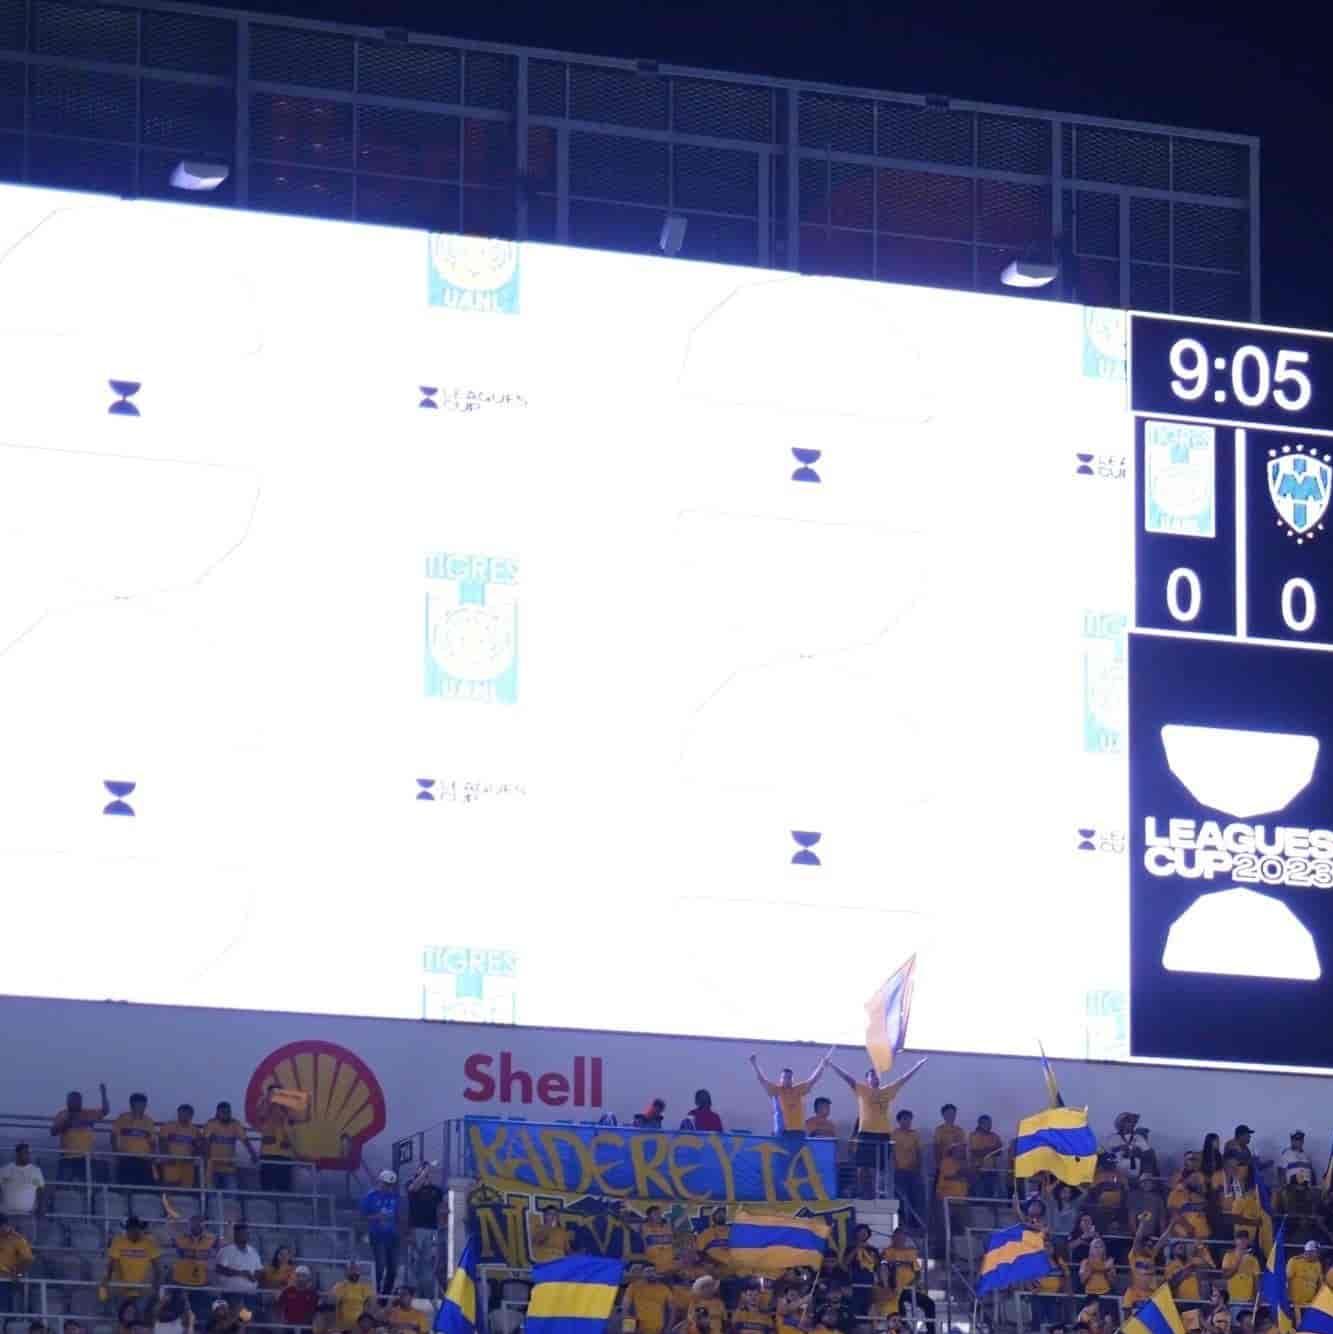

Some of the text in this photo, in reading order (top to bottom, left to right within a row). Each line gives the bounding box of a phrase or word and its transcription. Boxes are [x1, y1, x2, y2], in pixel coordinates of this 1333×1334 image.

[1168, 338, 1312, 411] 9:05
[1166, 567, 1202, 622] 0
[1281, 578, 1317, 631] 0
[1144, 846, 1234, 879] CUP
[463, 1052, 603, 1108] Shell
[466, 1122, 829, 1203] KADEREYTA
